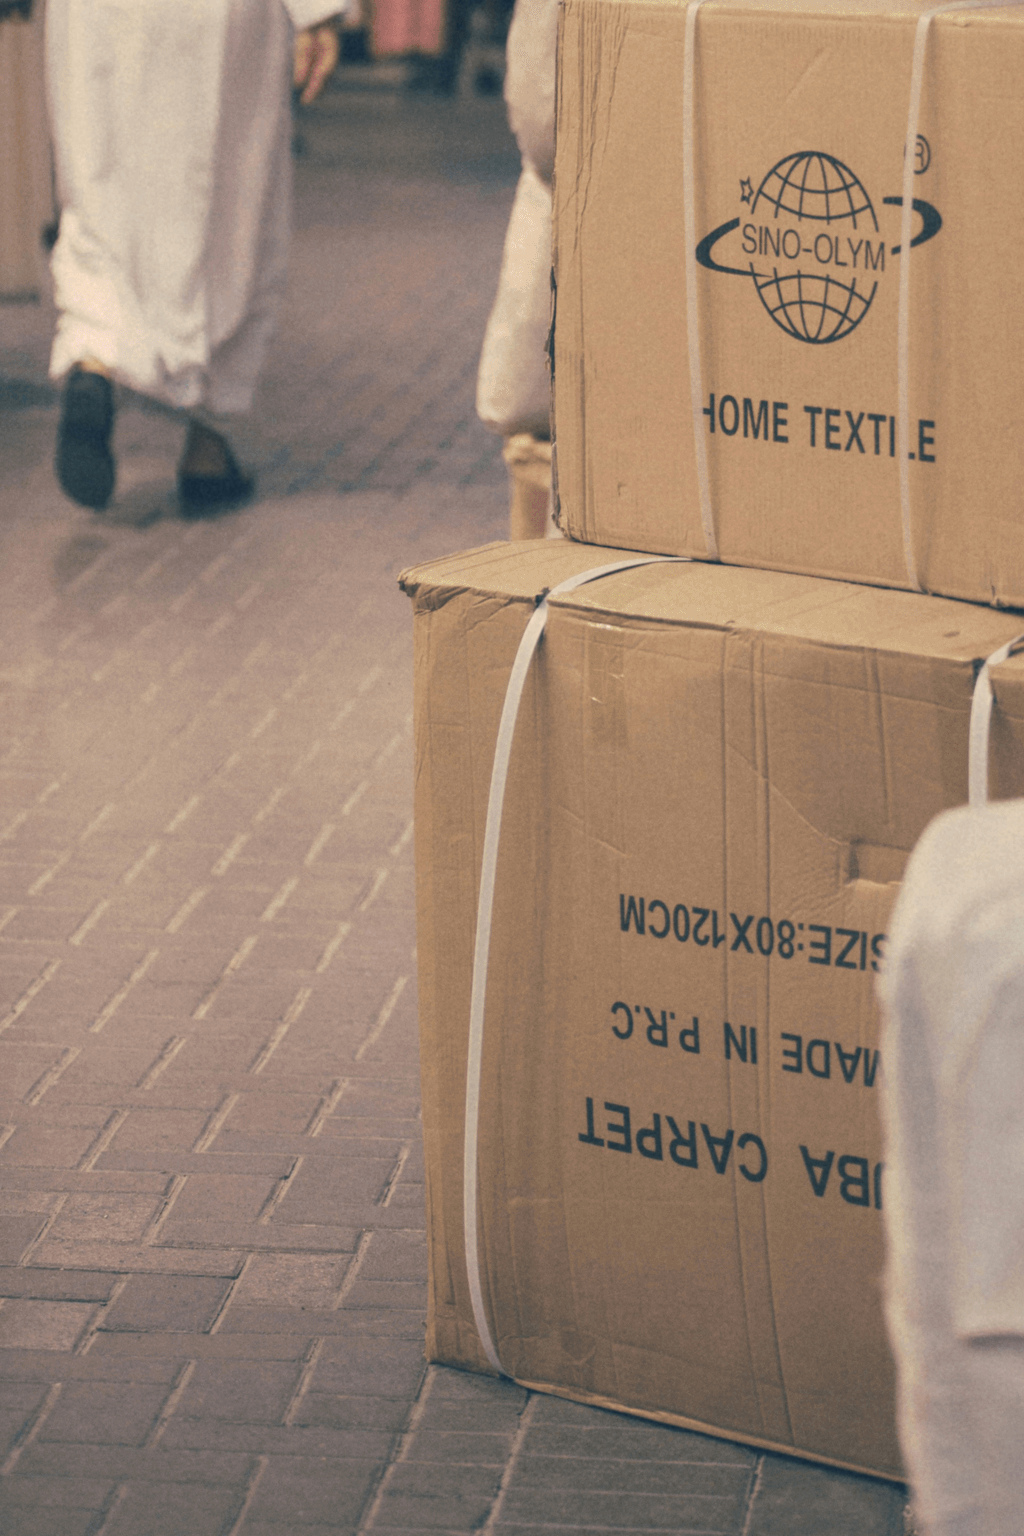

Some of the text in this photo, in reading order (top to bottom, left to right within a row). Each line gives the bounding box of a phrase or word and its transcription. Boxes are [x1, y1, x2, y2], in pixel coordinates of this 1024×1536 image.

[741, 223, 886, 273] SINO-OLYM
[803, 405, 936, 463] TEXTIE
[610, 1001, 701, 1055] P.R.C
[723, 1022, 758, 1065] IN
[577, 1096, 768, 1183] CARPET
